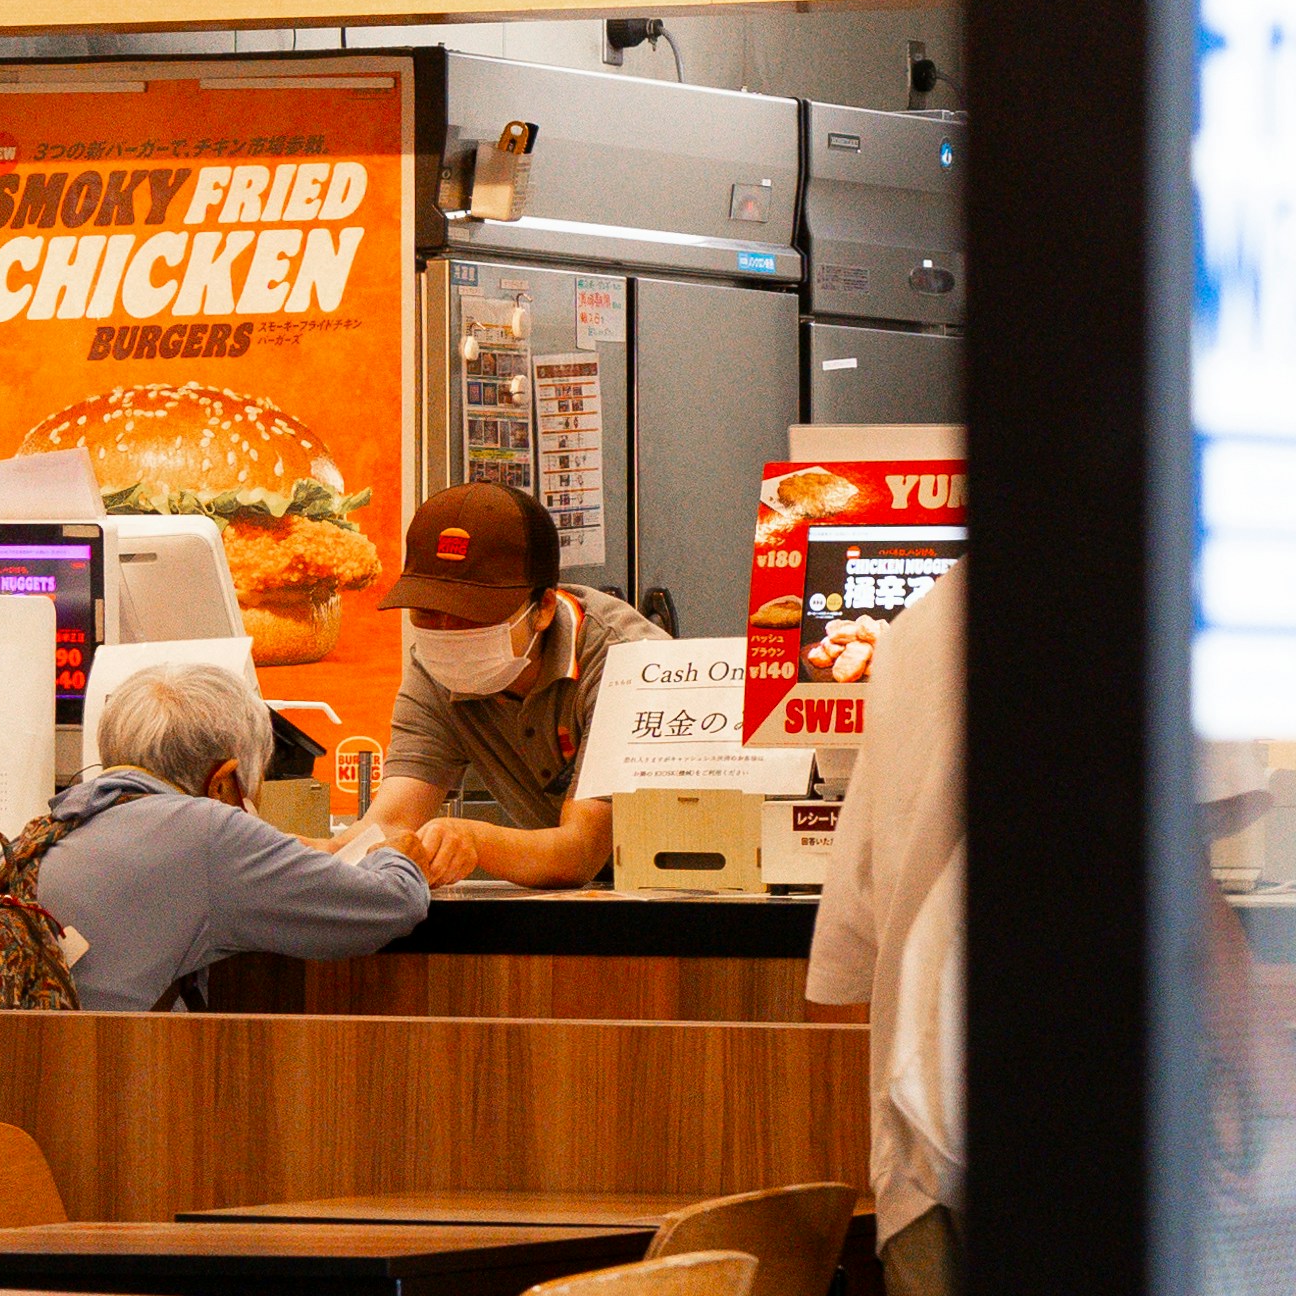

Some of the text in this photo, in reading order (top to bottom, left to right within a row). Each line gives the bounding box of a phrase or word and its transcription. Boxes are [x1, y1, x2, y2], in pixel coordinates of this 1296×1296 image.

[182, 161, 369, 225] FRIED
[258, 318, 363, 333] スモーキーフライドチキン
[86, 321, 254, 361] BURGERS
[257, 334, 303, 346] バーガーズ
[757, 550, 803, 569] ¥180
[0, 575, 57, 592] NUGGETS
[750, 633, 785, 644] ハッシュ
[750, 646, 786, 658] ブラウン
[640, 661, 699, 684] Cash
[749, 661, 796, 681] ¥140
[338, 754, 381, 765] BURR
[338, 765, 381, 781] KIG
